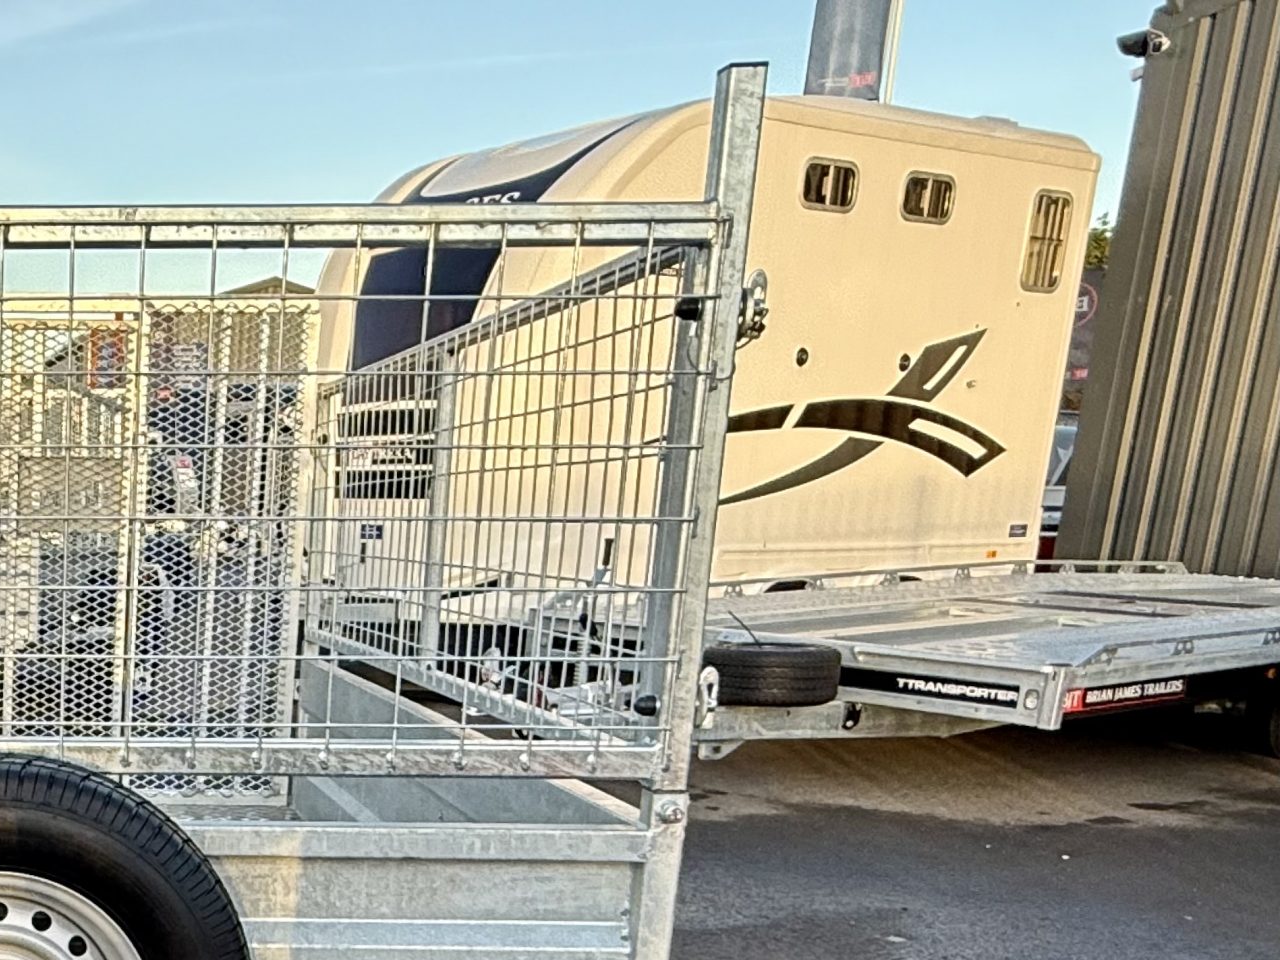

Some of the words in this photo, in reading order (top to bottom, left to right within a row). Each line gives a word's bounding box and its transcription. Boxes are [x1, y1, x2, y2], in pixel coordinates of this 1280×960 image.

[1085, 689, 1114, 703] BRIAN
[1114, 685, 1142, 701] JAMES
[1143, 679, 1184, 696] TRAILERS
